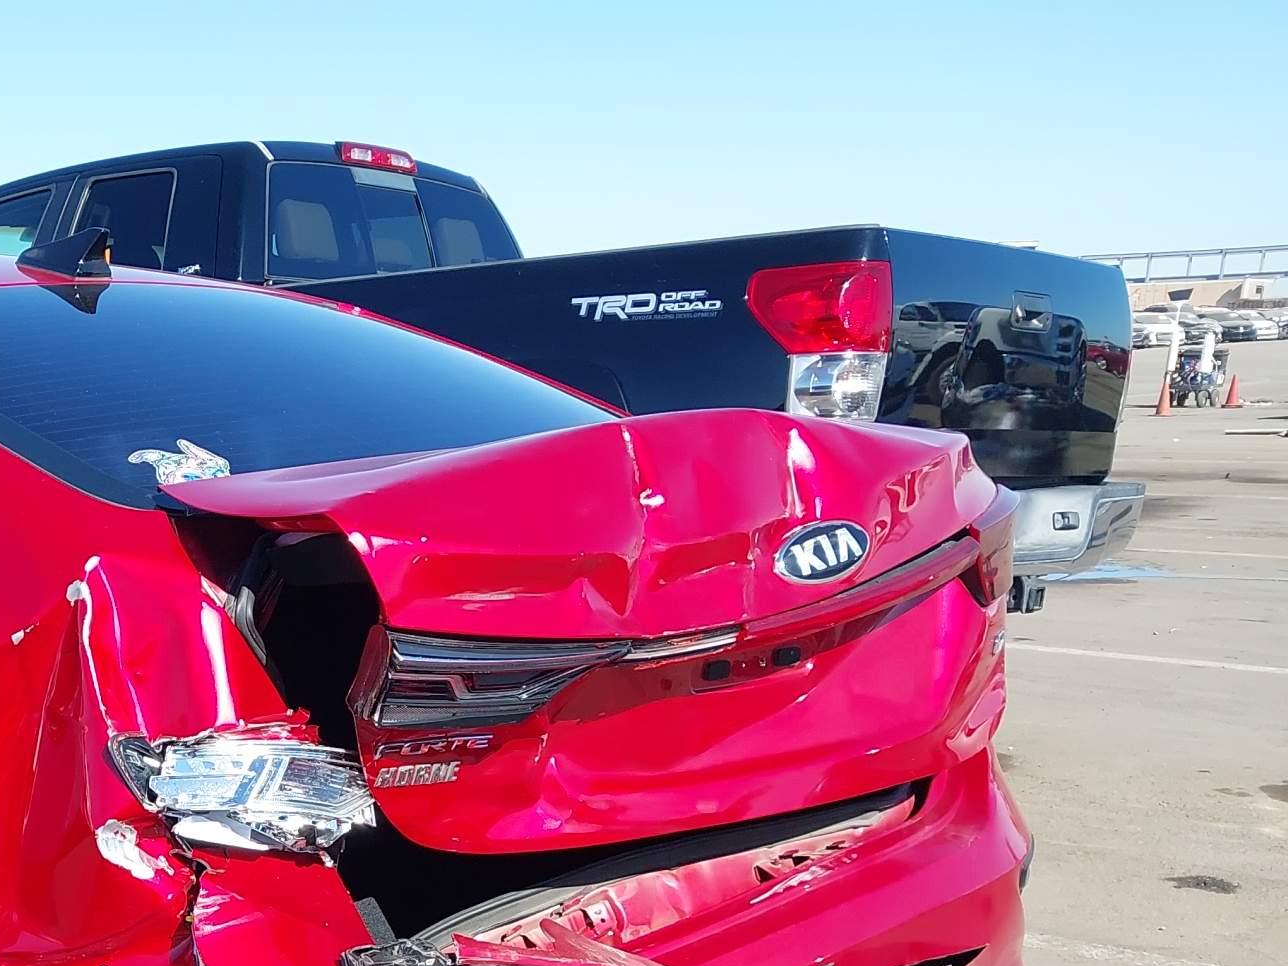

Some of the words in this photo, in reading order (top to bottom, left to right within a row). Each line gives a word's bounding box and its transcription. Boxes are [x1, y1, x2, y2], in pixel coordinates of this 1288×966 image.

[571, 292, 657, 322] TRD
[658, 300, 723, 312] ROAD
[660, 289, 708, 301] OFF
[789, 527, 863, 576] KIA
[373, 734, 494, 760] FORTE
[373, 761, 461, 788] HORNE
